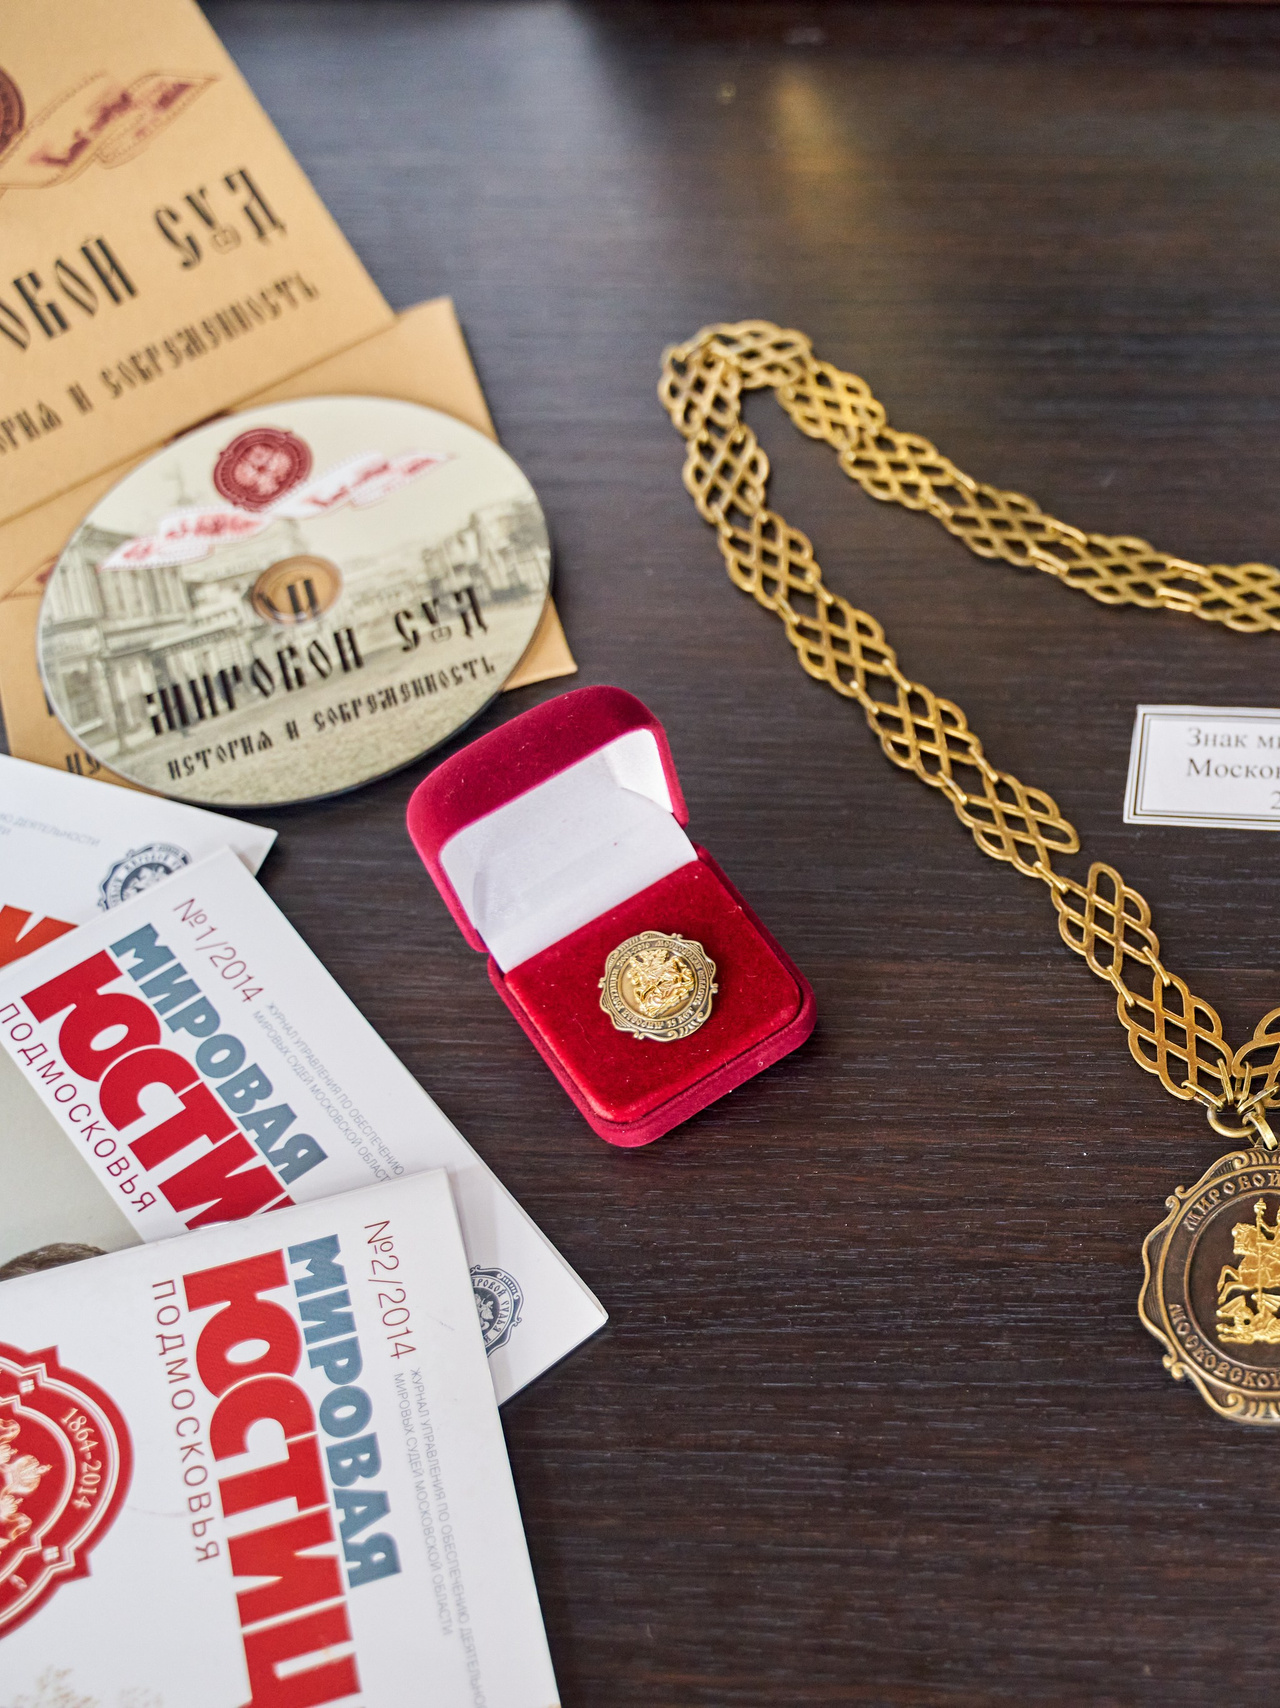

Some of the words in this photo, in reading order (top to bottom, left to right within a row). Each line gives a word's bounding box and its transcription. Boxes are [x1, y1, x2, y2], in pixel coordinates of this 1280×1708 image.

[394, 586, 488, 652] СУД
[285, 720, 300, 742] И
[1187, 727, 1248, 749] Знак
[173, 898, 264, 1003] №1/2014
[0, 1003, 157, 1213] ПОДМОСКОВЬЯ
[21, 949, 296, 1231] ЮСТИ
[109, 923, 329, 1186] МИРОВАЯ
[252, 1010, 289, 1057] МИРОВЫХ
[286, 1050, 315, 1087] СУДЕЙ
[310, 1083, 364, 1149] МОСКОВСКОЙ
[358, 1146, 392, 1182] ОБЛАСТ
[267, 1002, 298, 1041] ЖУРНАЛ
[296, 1037, 342, 1095] УПРАВЛЕНИЯ
[336, 1093, 353, 1110] ПО
[349, 1107, 405, 1176] ОБЕСПЕЧЕНИЮ
[365, 1220, 418, 1360] №2/2014
[60, 1407, 103, 1509] 1864-2014
[151, 1281, 220, 1564] ПОДМОСКОВЬЯ
[288, 1234, 403, 1588] МИРОВАЯ
[410, 1367, 430, 1418] ЖУРНАЛ
[421, 1419, 447, 1500] УПРАВЛЕНИЯ
[181, 1249, 362, 1708] ЮСТИЦ
[394, 1372, 415, 1436] МИРОВЫХ
[406, 1436, 423, 1479] СУДЕЙ
[415, 1480, 443, 1571] МОСКОВСКОЙ
[432, 1573, 453, 1636] ОБЛАСТИ
[437, 1502, 451, 1522] ПО
[441, 1524, 470, 1624] ОБЕСПЕЧЕНИЮ
